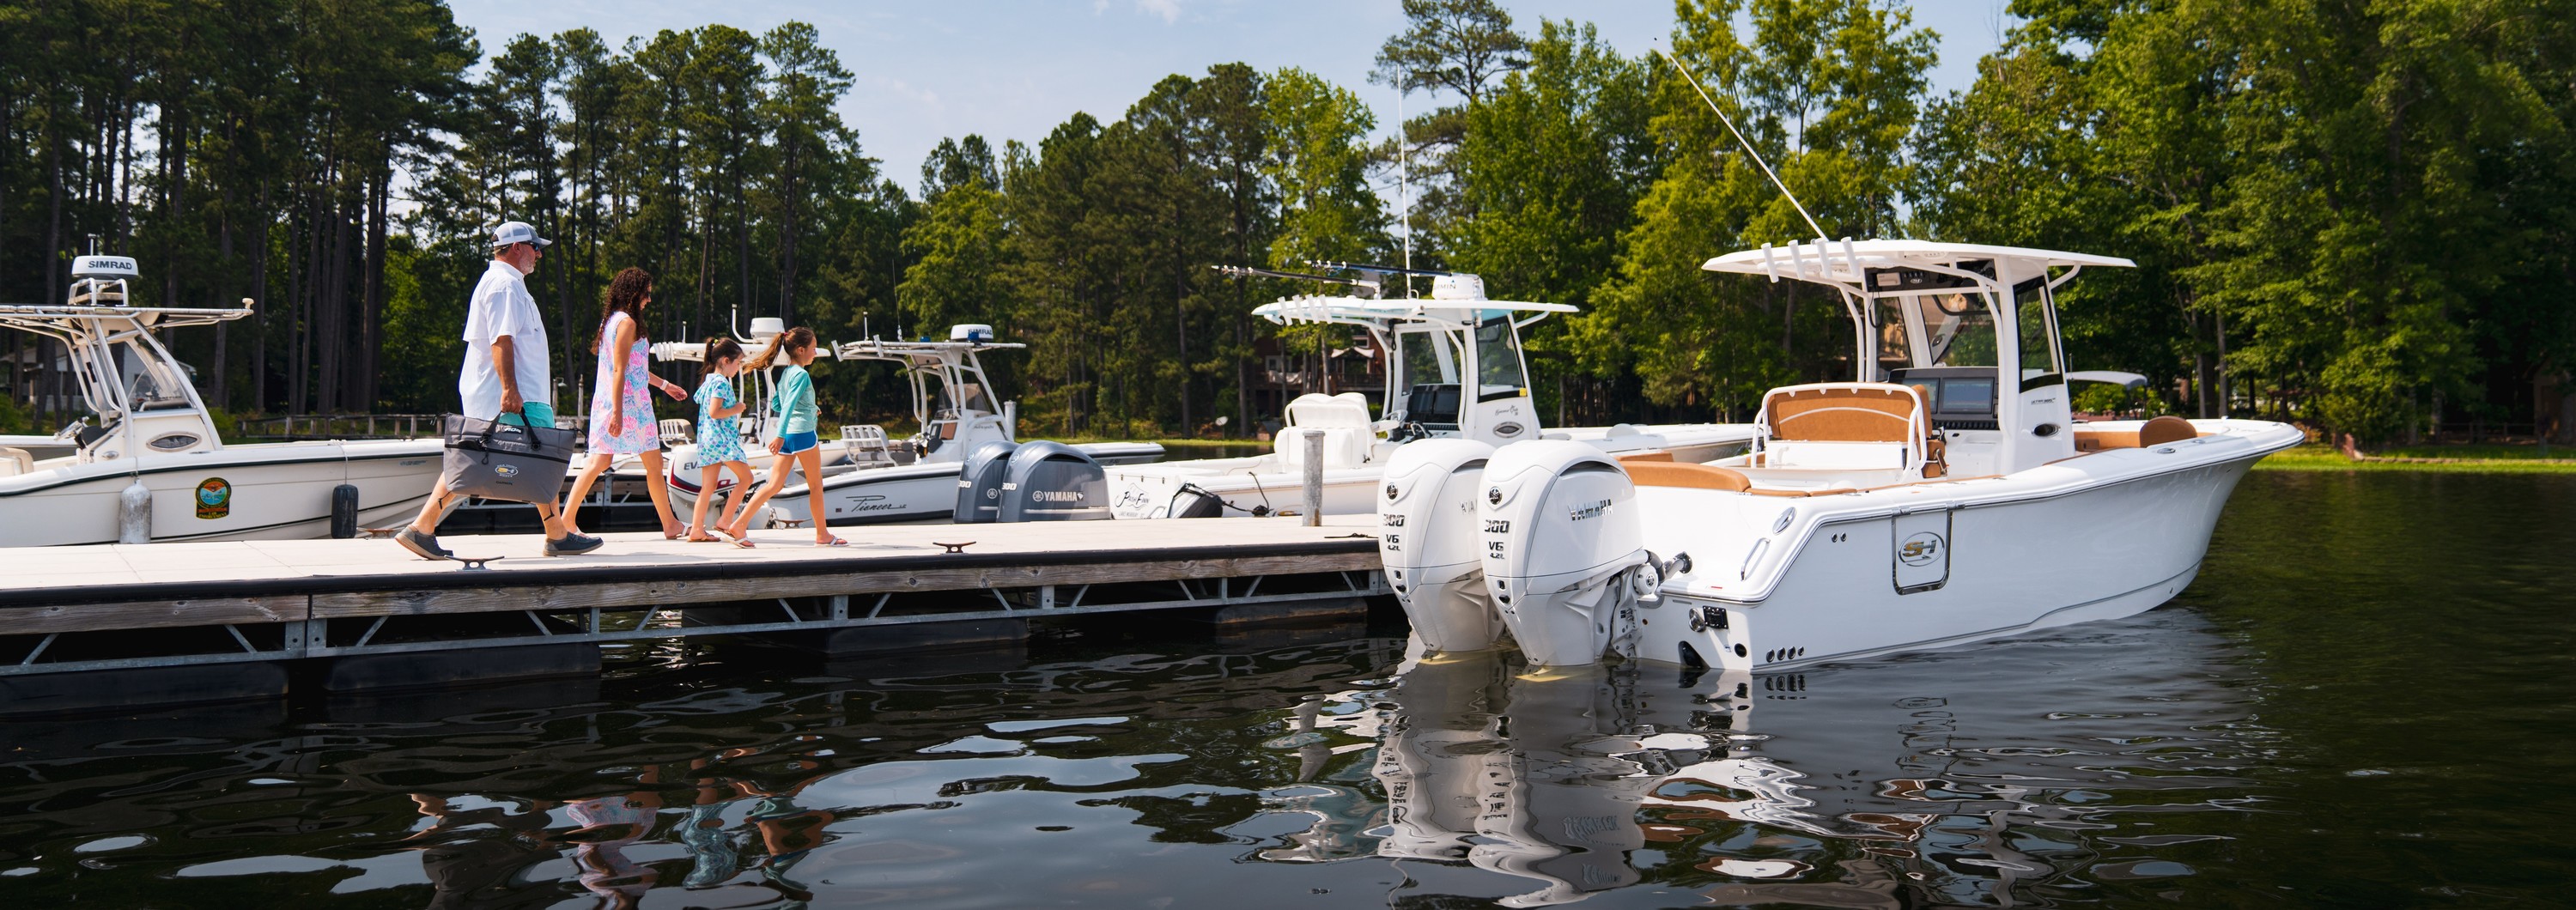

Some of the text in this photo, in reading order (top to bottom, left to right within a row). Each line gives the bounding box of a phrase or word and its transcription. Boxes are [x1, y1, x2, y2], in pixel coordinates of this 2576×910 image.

[88, 260, 133, 270] SIMRAD
[1044, 491, 1078, 502] YAMAHA
[845, 494, 894, 513] Pioneer
[1567, 499, 1613, 521] YAMAHA
[1383, 513, 1406, 527] 300
[1484, 519, 1511, 534] 300
[1386, 534, 1400, 543] V6
[1488, 541, 1504, 551] V6
